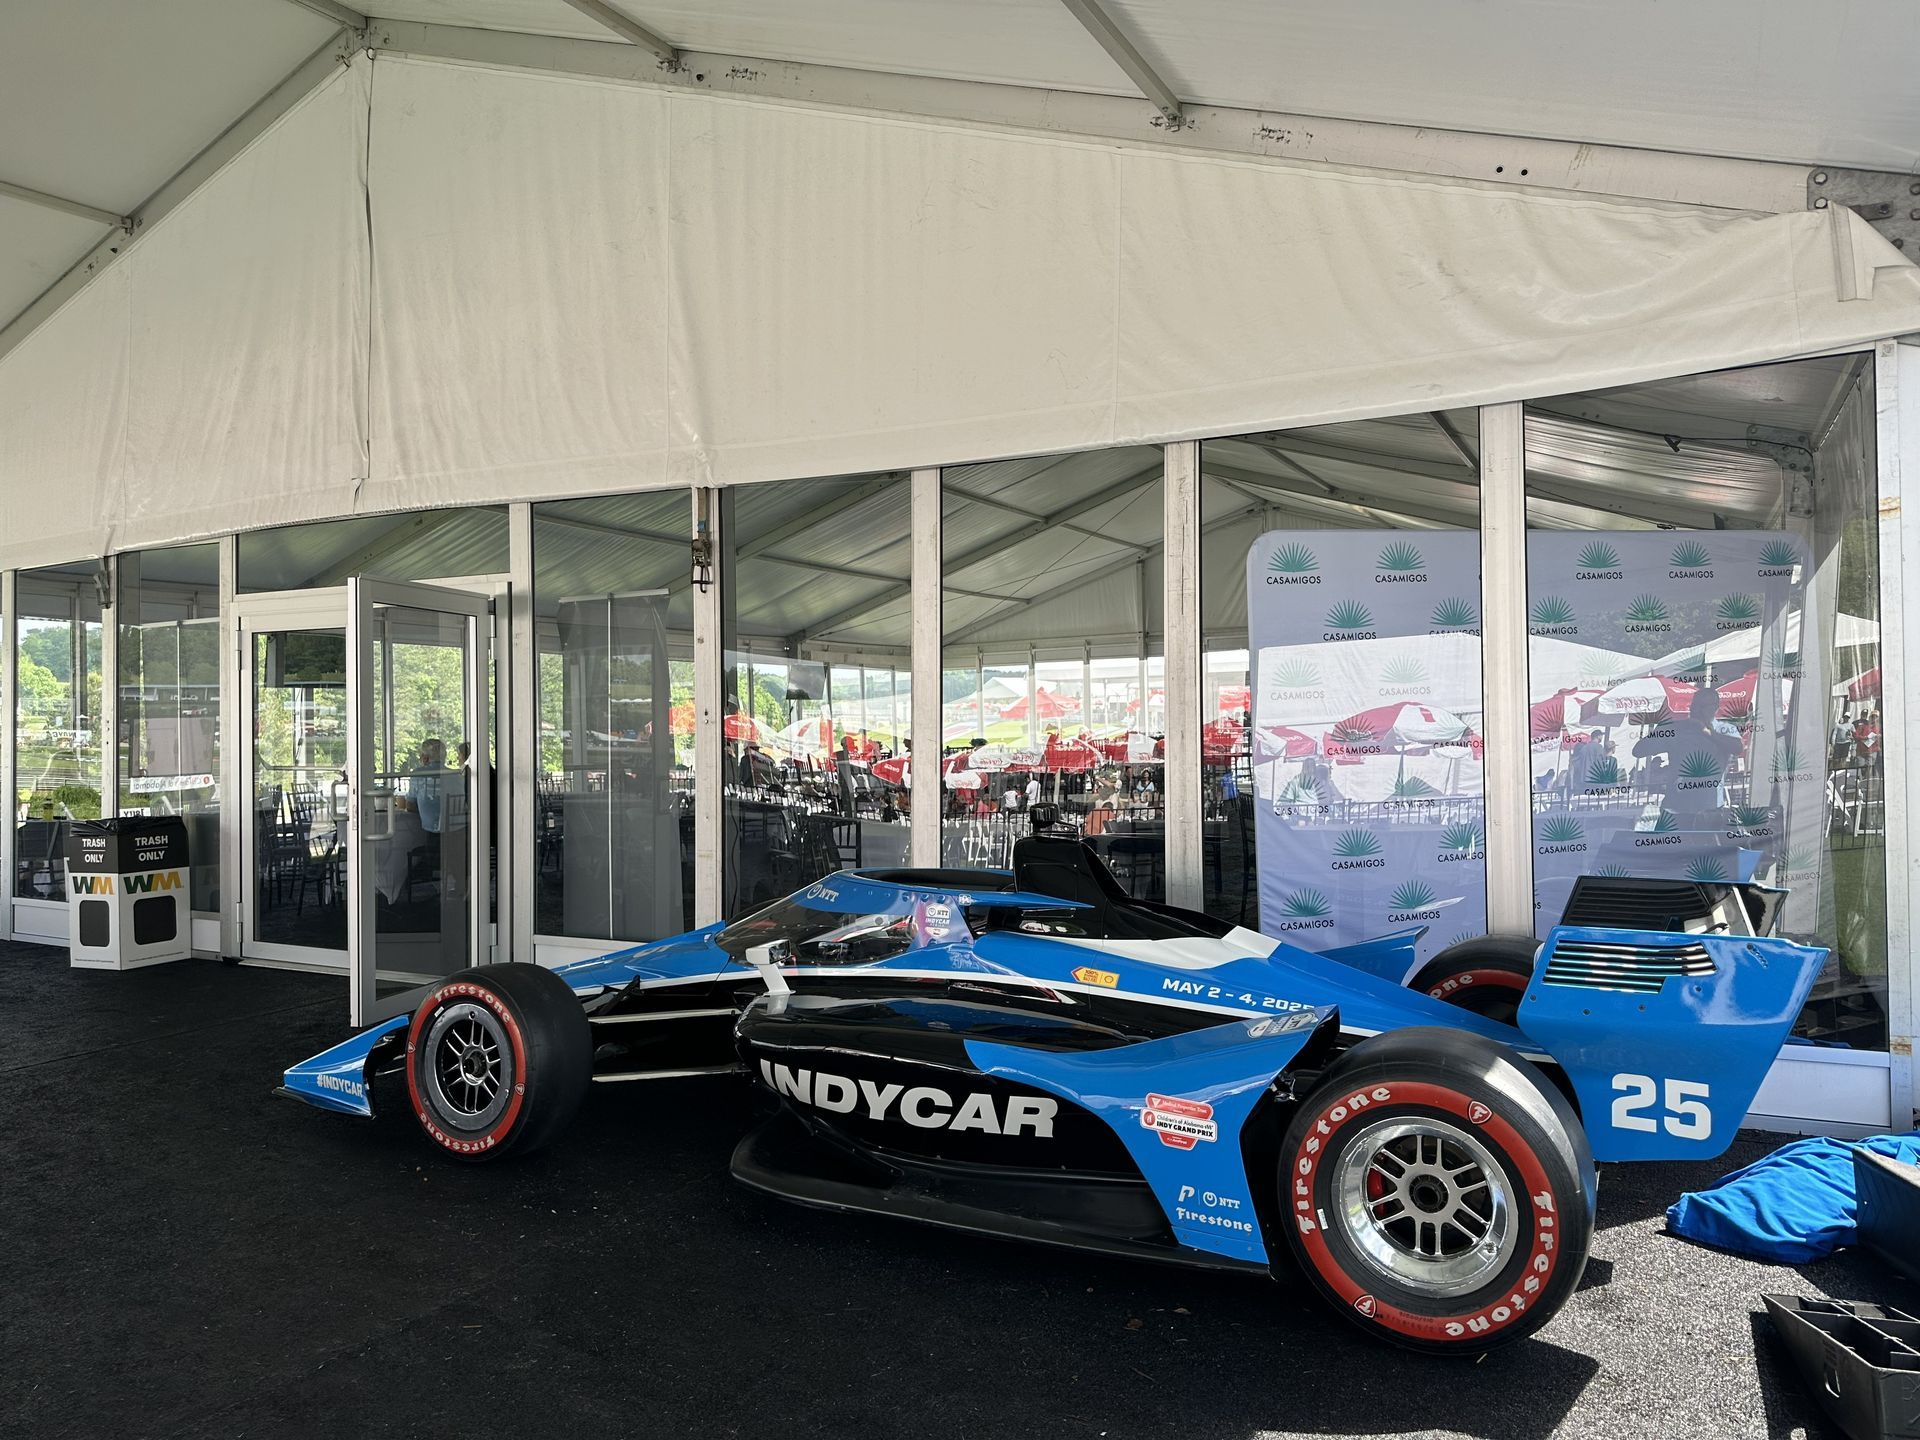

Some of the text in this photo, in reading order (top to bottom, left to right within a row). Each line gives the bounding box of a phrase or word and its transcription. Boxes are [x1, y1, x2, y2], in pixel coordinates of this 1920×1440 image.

[1375, 574, 1428, 583] CASAMIGOS
[1576, 571, 1623, 580] CASAMIGOS
[1668, 570, 1714, 579] CASAMIGOS
[1757, 569, 1793, 577] CASAMIG
[1266, 576, 1322, 585] CASAMIGOS
[1625, 623, 1671, 633] CASAMIGOS
[1716, 620, 1761, 630] CASAMIGOS
[1323, 631, 1377, 642] CASAMIGOS
[1530, 626, 1578, 636] CASAMIGOS
[1674, 674, 1718, 684] CASAMIGOS
[1763, 670, 1807, 680] CASAMIGOS
[1580, 678, 1626, 688] CASAMIGOS
[1270, 690, 1325, 701] CASAMIGOS
[1378, 686, 1432, 697] CASAMIGOS
[1629, 729, 1676, 739] CASAMIGOS
[1720, 724, 1765, 734] CASAMIGOS
[1327, 745, 1381, 756] CASAMIGOS
[1768, 773, 1813, 784] CASAMIGOS
[1678, 780, 1723, 790] CASAMIGOS
[1584, 786, 1632, 796] CASAMIGOS
[1726, 828, 1774, 839] CASAMIGOS
[82, 838, 106, 848] TRASH
[135, 835, 168, 847] TRASH
[1635, 836, 1682, 847] CASAMIGOS
[1538, 844, 1587, 854] CASAMIGOS
[84, 854, 104, 863] ONLY
[138, 851, 165, 861] ONLY
[1438, 852, 1484, 863] CASAMIGO
[1332, 859, 1385, 870] CASAMIGOS
[72, 876, 114, 895] WM
[124, 871, 183, 895] WM
[818, 887, 839, 903] NTT
[1388, 911, 1440, 923] CASAMIGOS
[1280, 920, 1334, 931] CASAMIGOS
[1162, 978, 1204, 995] MAY
[1208, 987, 1222, 998] 2
[1239, 993, 1257, 1007] 4,
[434, 982, 511, 1023] Firestone
[316, 1073, 364, 1098] #INDYCAR
[760, 1058, 1058, 1138] INDYCAR
[1612, 1072, 1712, 1140] 25
[1156, 1114, 1177, 1124] Children's
[1184, 1120, 1204, 1129] Alabama
[420, 1112, 496, 1152] Firestone
[1156, 1121, 1173, 1130] INDY
[1174, 1124, 1196, 1134] GRAND
[1197, 1130, 1214, 1138] PRIX
[1296, 1087, 1391, 1235] Firestone
[1219, 1196, 1240, 1209] NTT
[1176, 1206, 1253, 1232] Firestone
[1445, 1190, 1556, 1336] Firestone
